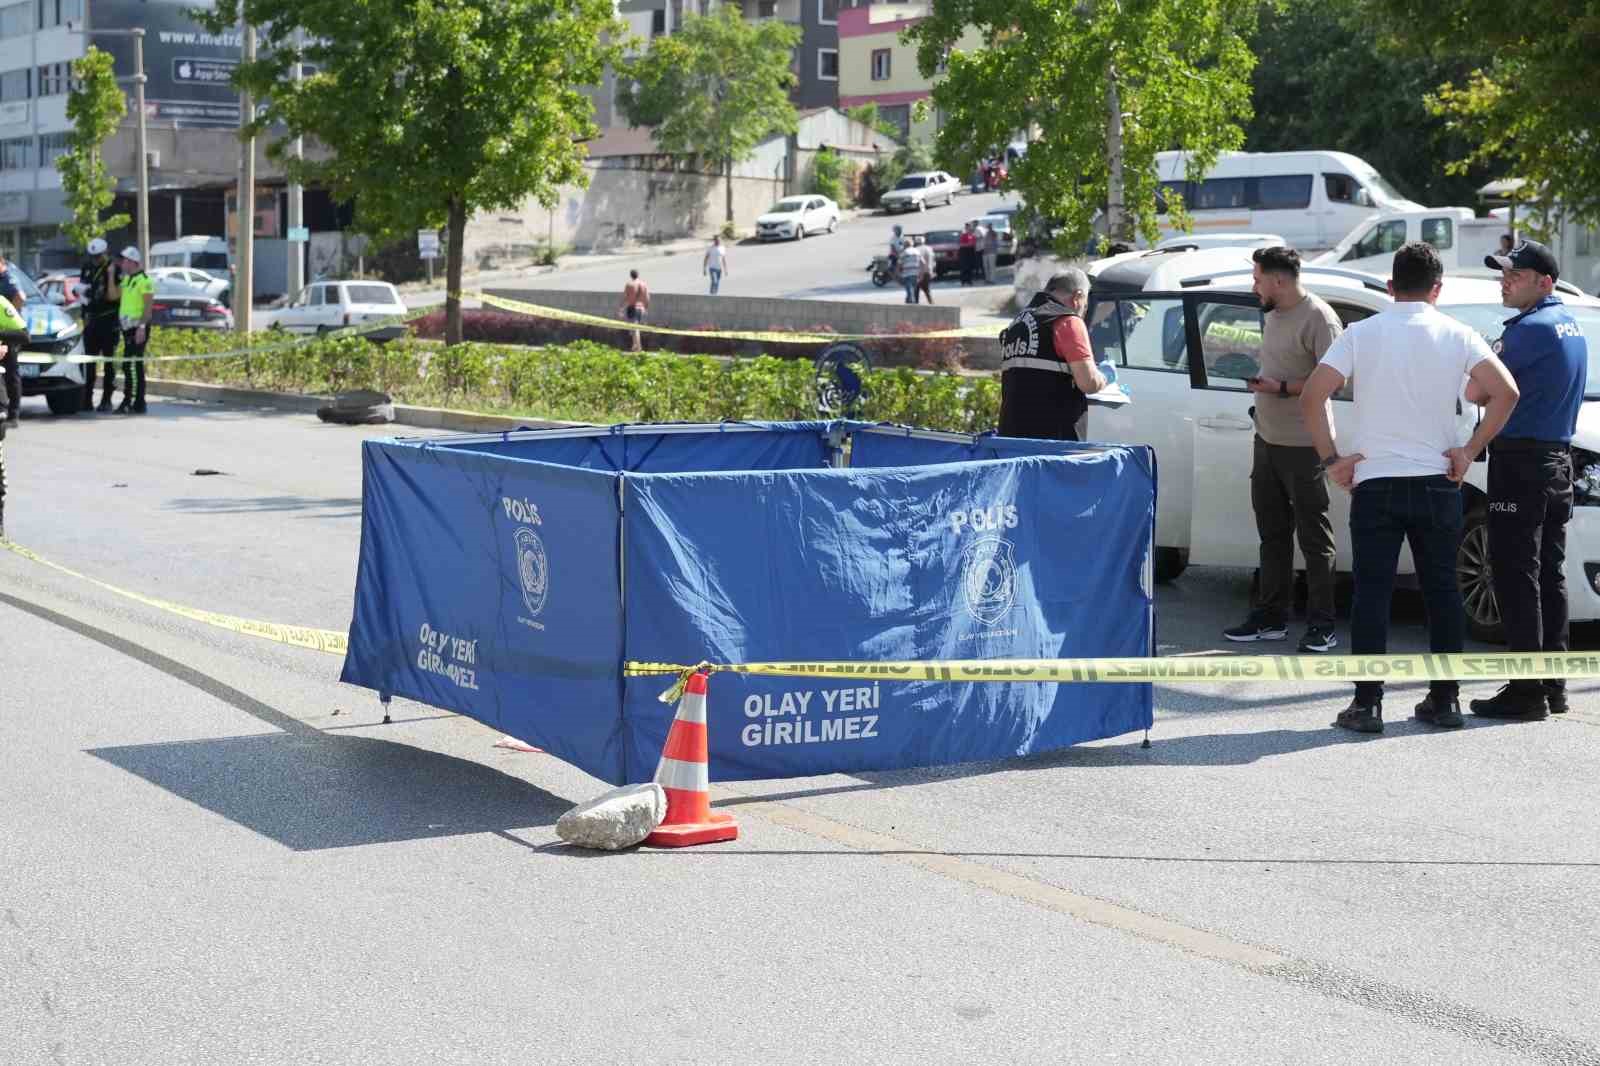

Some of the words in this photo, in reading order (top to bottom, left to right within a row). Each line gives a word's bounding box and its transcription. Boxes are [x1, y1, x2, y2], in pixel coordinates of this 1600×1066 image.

[744, 690, 813, 718] OLAY
[821, 681, 880, 713] YERİ
[741, 715, 879, 747] GİRİLMEZ
